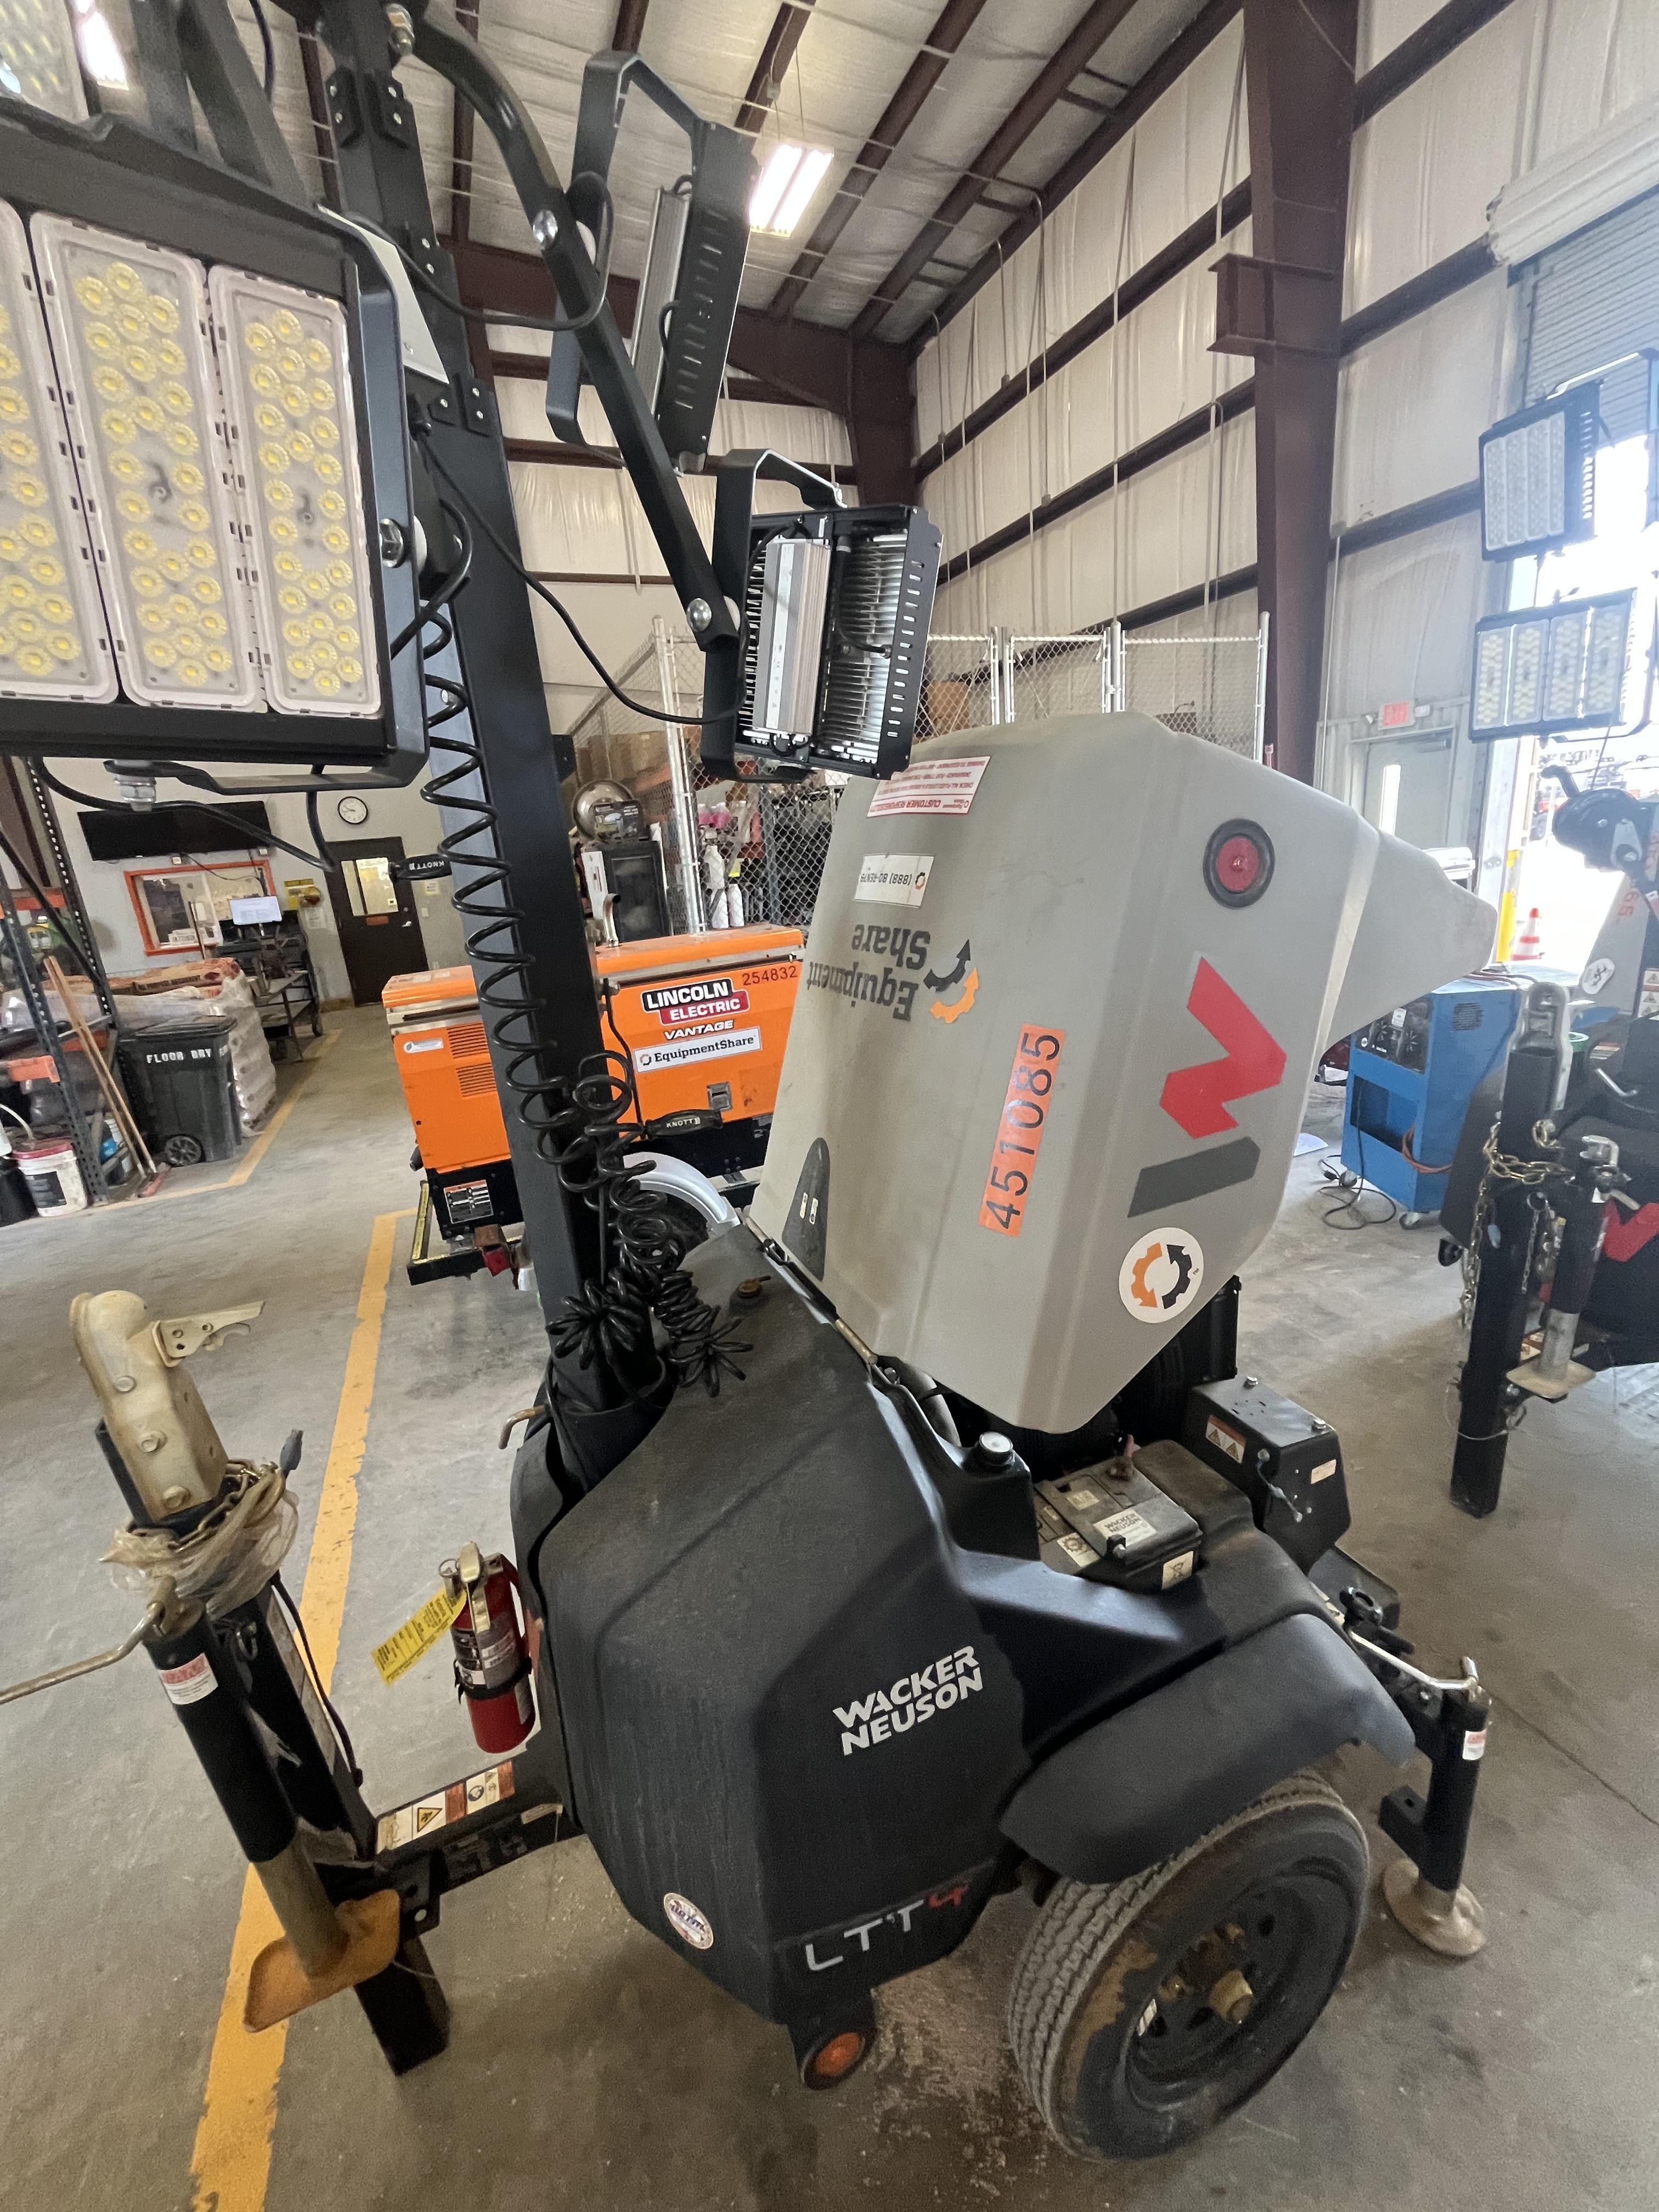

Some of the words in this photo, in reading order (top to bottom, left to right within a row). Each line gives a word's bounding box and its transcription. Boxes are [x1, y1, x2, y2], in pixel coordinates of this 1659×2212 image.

[417, 860, 444, 870] KNOTT
[889, 872, 912, 886] (888)
[851, 924, 931, 970] Share
[742, 966, 798, 986] 254832
[646, 981, 729, 1009] LINCOLN
[806, 961, 919, 1022] Equipment
[669, 998, 741, 1022] ELECTRIC
[664, 1019, 734, 1041] VANTAGE
[146, 1051, 184, 1064] FLOOR
[654, 1035, 755, 1063] EquipmentShare
[666, 1118, 693, 1128] KNOTT
[986, 1032, 1060, 1230] 451085
[832, 1646, 979, 1728] WACKER
[841, 1667, 983, 1756] NEUSON
